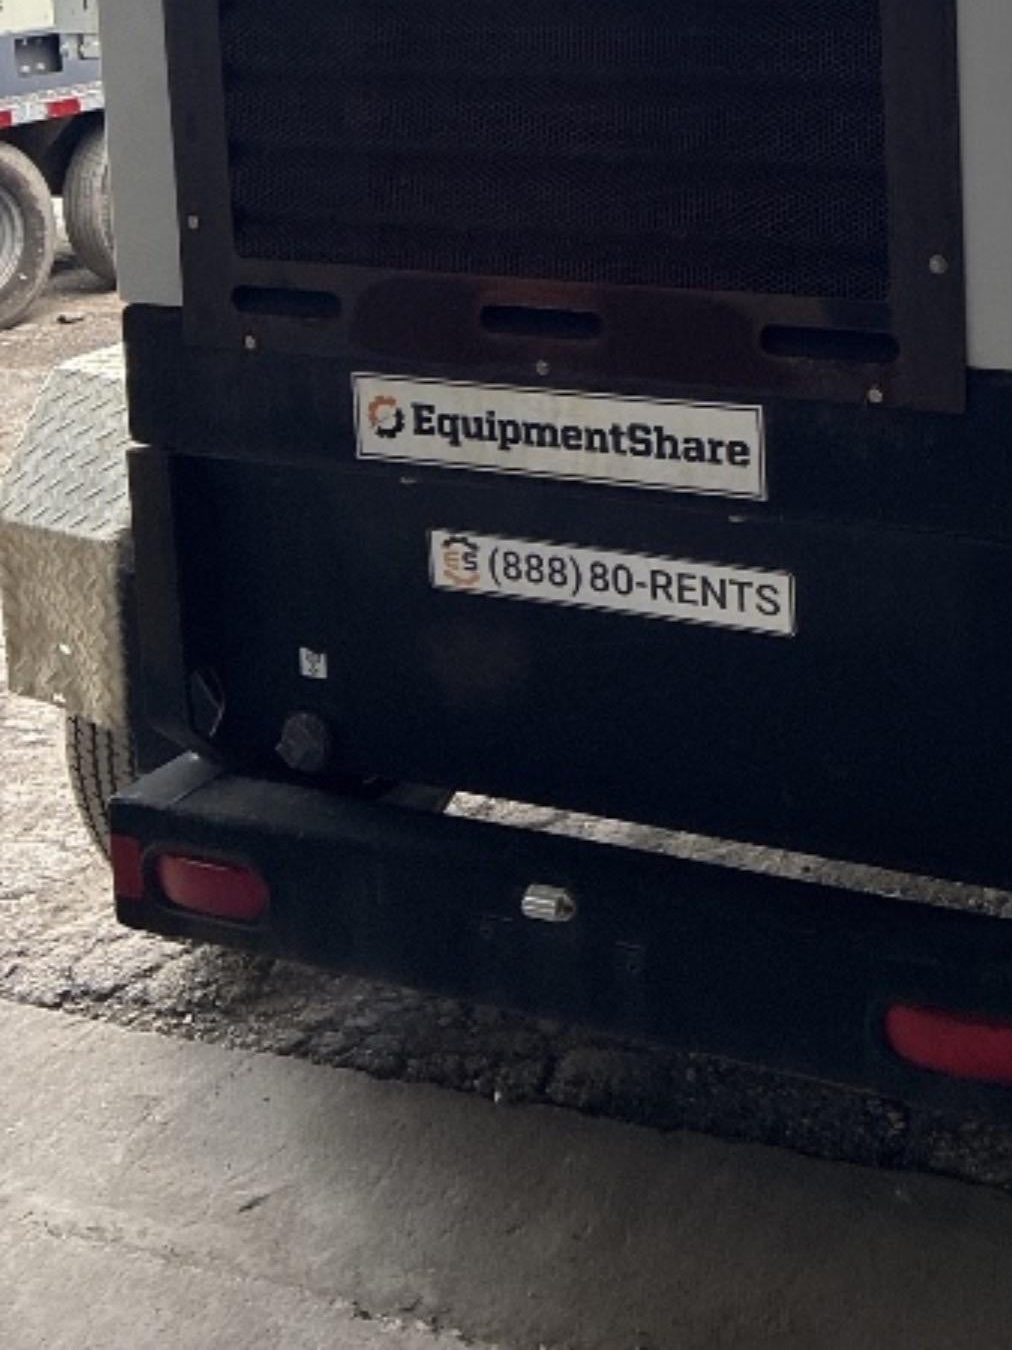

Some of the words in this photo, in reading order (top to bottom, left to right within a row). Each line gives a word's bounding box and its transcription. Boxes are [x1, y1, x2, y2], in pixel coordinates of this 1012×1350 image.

[410, 402, 751, 468] EquipmentShare
[488, 545, 581, 597] (888)
[590, 564, 782, 617] 80-RENTS
